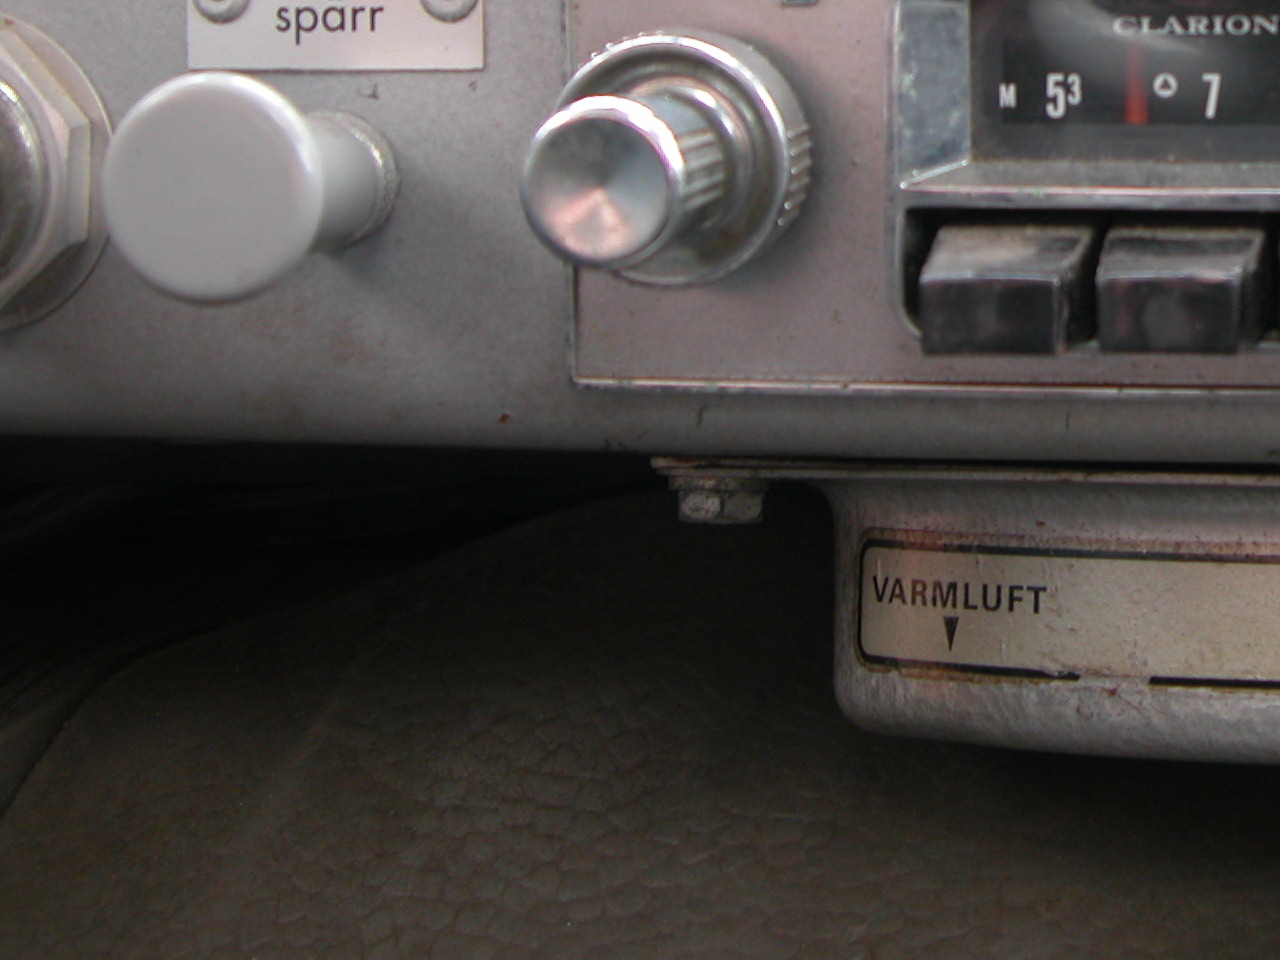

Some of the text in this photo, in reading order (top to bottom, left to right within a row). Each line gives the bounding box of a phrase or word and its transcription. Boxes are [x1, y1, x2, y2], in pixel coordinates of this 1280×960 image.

[1112, 14, 1280, 36] CLARION
[1202, 73, 1222, 120] 7
[872, 575, 1048, 615] VARMLUFT
